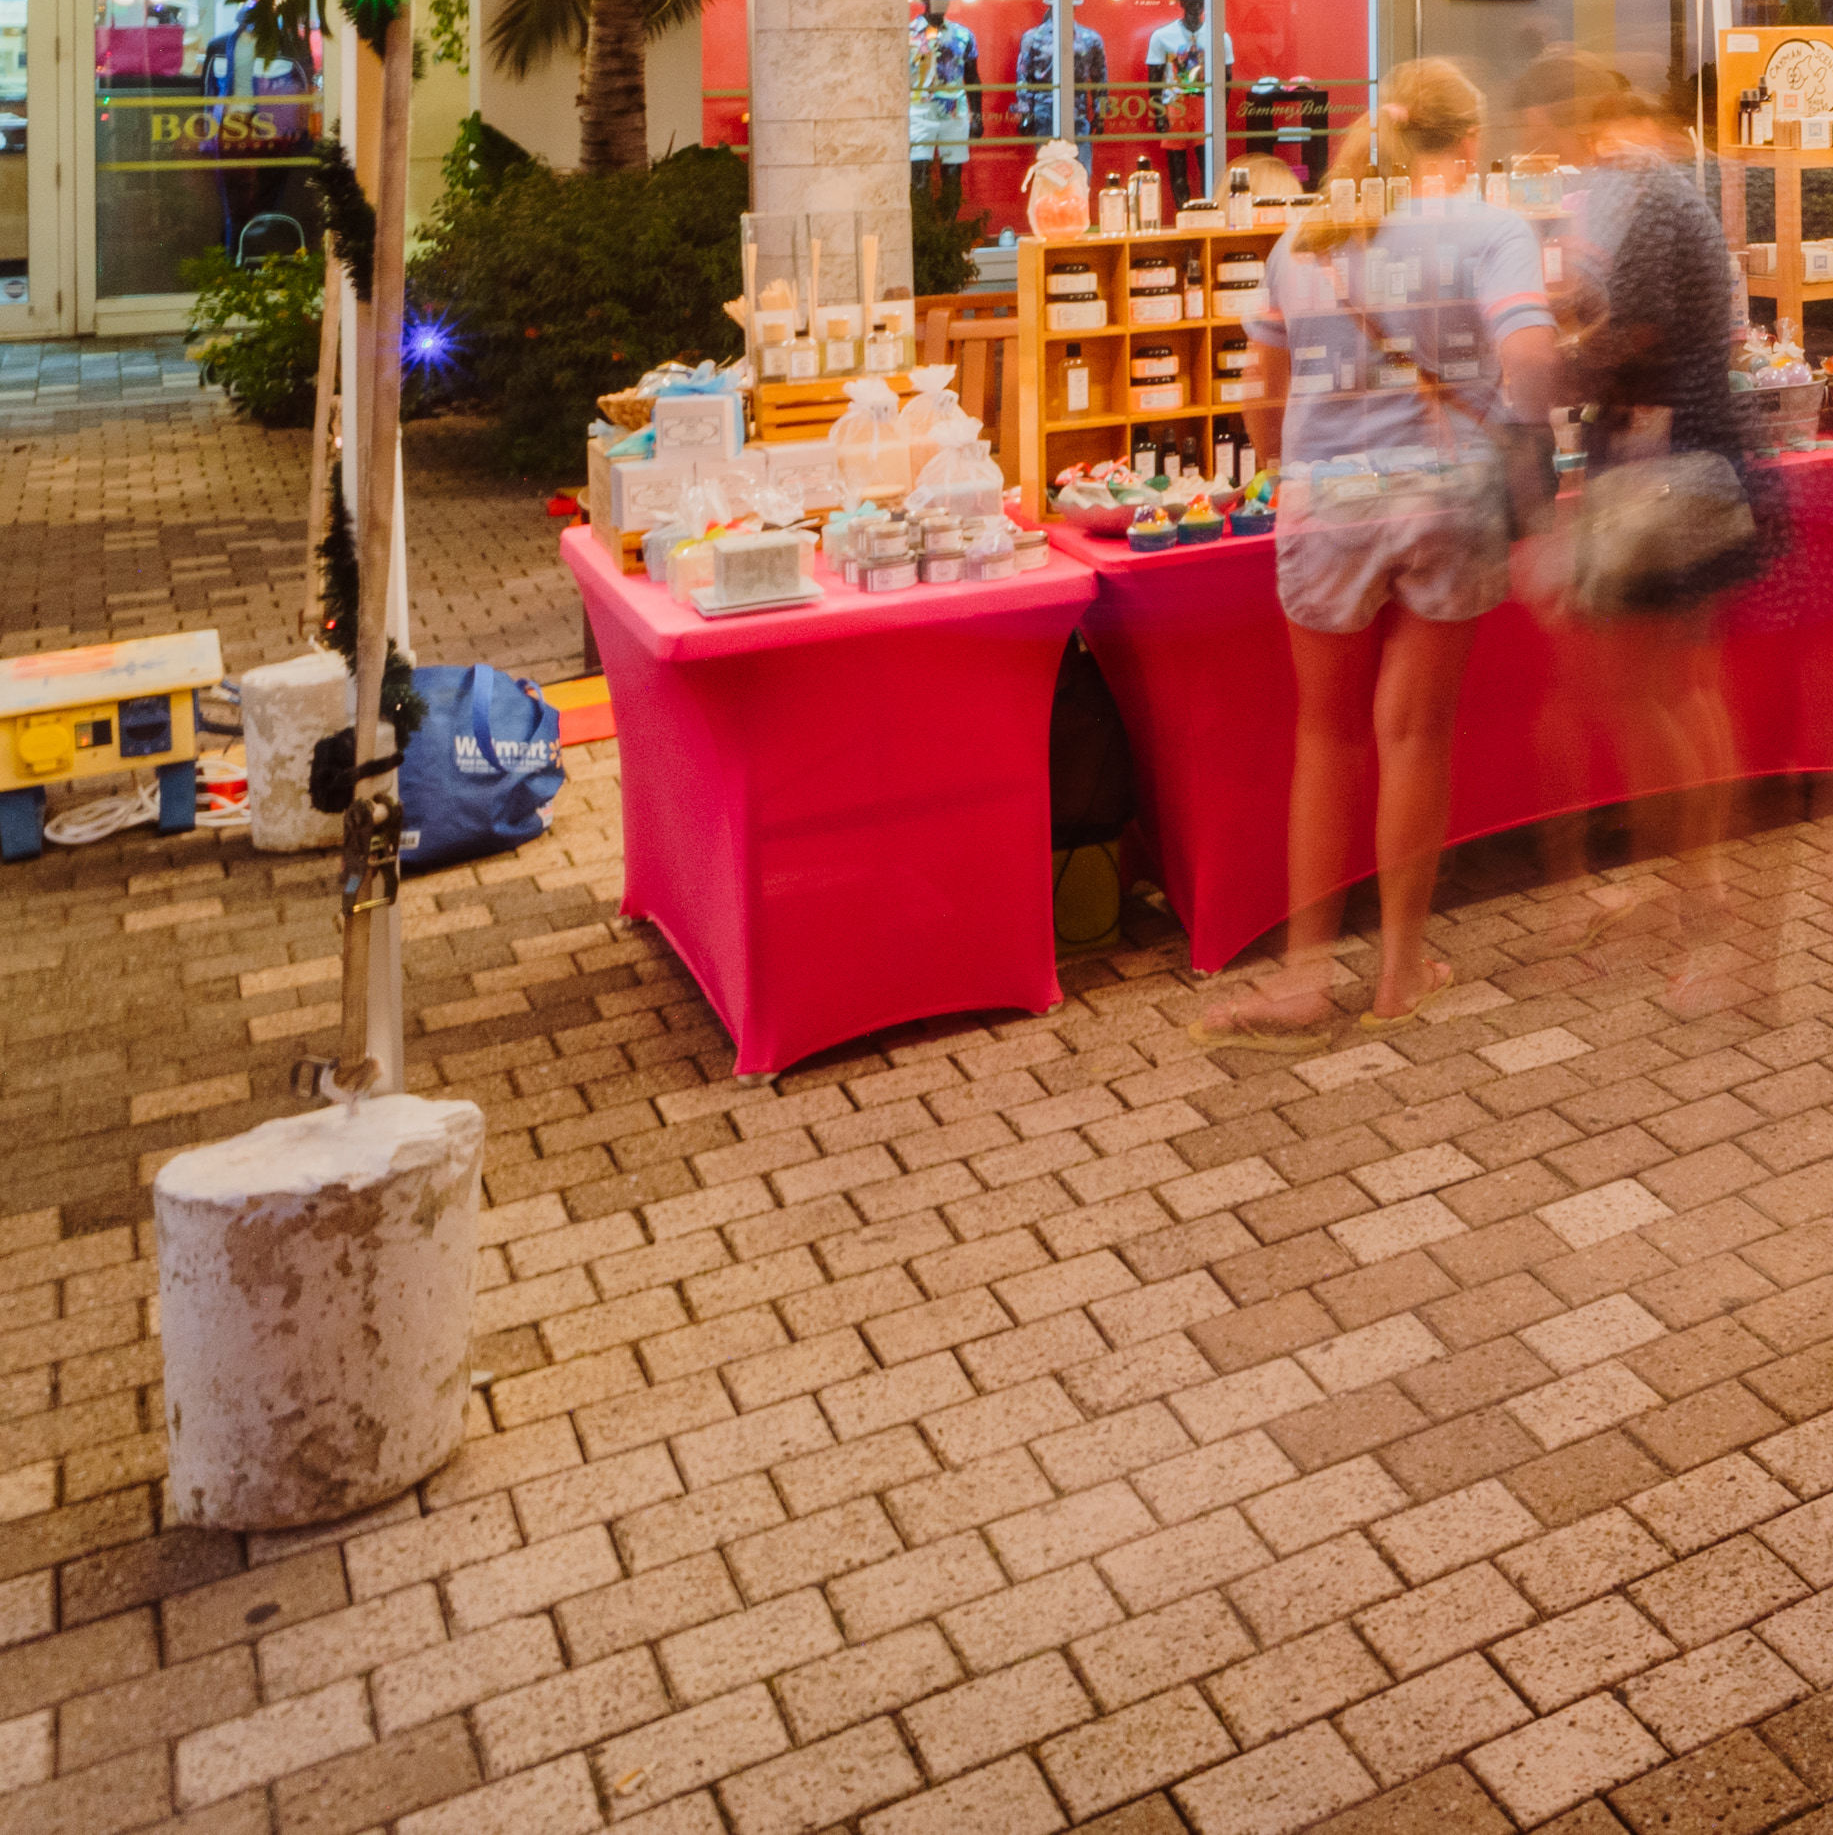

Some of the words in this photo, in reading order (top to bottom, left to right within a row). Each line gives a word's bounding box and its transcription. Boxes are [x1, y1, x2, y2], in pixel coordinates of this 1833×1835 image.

[1769, 49, 1801, 79] CAYMAN
[1099, 95, 1186, 119] BOSS
[1237, 101, 1294, 121] Tommy
[1300, 99, 1366, 115] Bahama
[152, 113, 277, 141] BOSS
